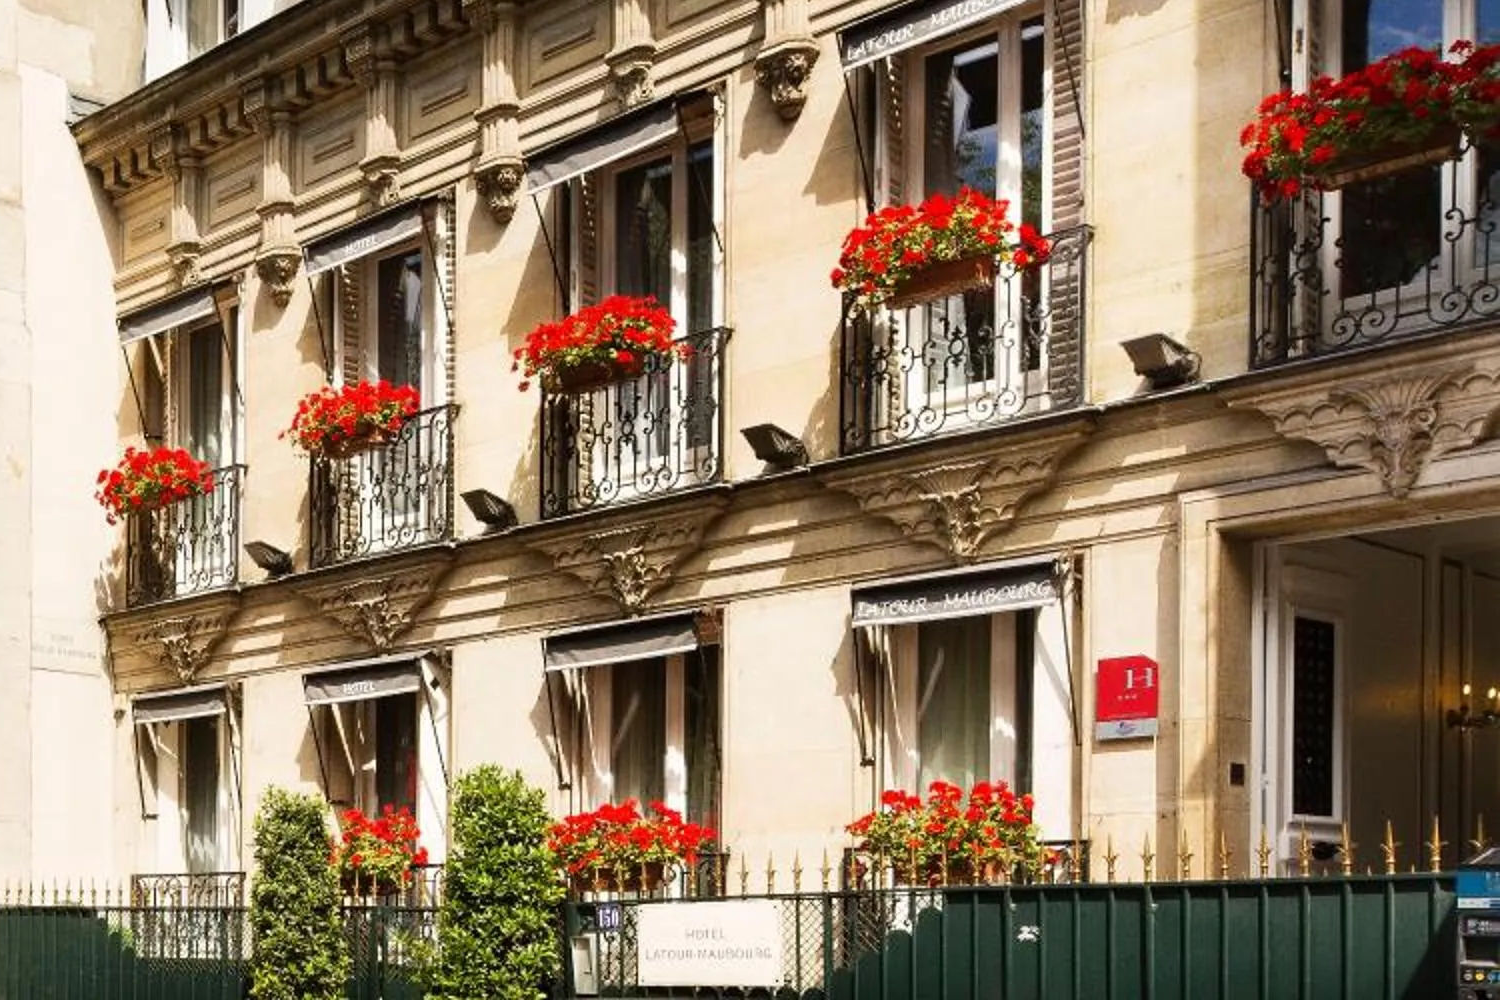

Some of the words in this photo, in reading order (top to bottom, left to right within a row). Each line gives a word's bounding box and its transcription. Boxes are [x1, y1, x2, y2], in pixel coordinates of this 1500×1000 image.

[847, 23, 915, 61] LATOUR
[858, 597, 927, 617] LATOUR
[944, 579, 1051, 611] MAUBOURG
[343, 681, 376, 694] HOTEL
[599, 908, 620, 928] 150
[685, 927, 725, 941] HOTEL
